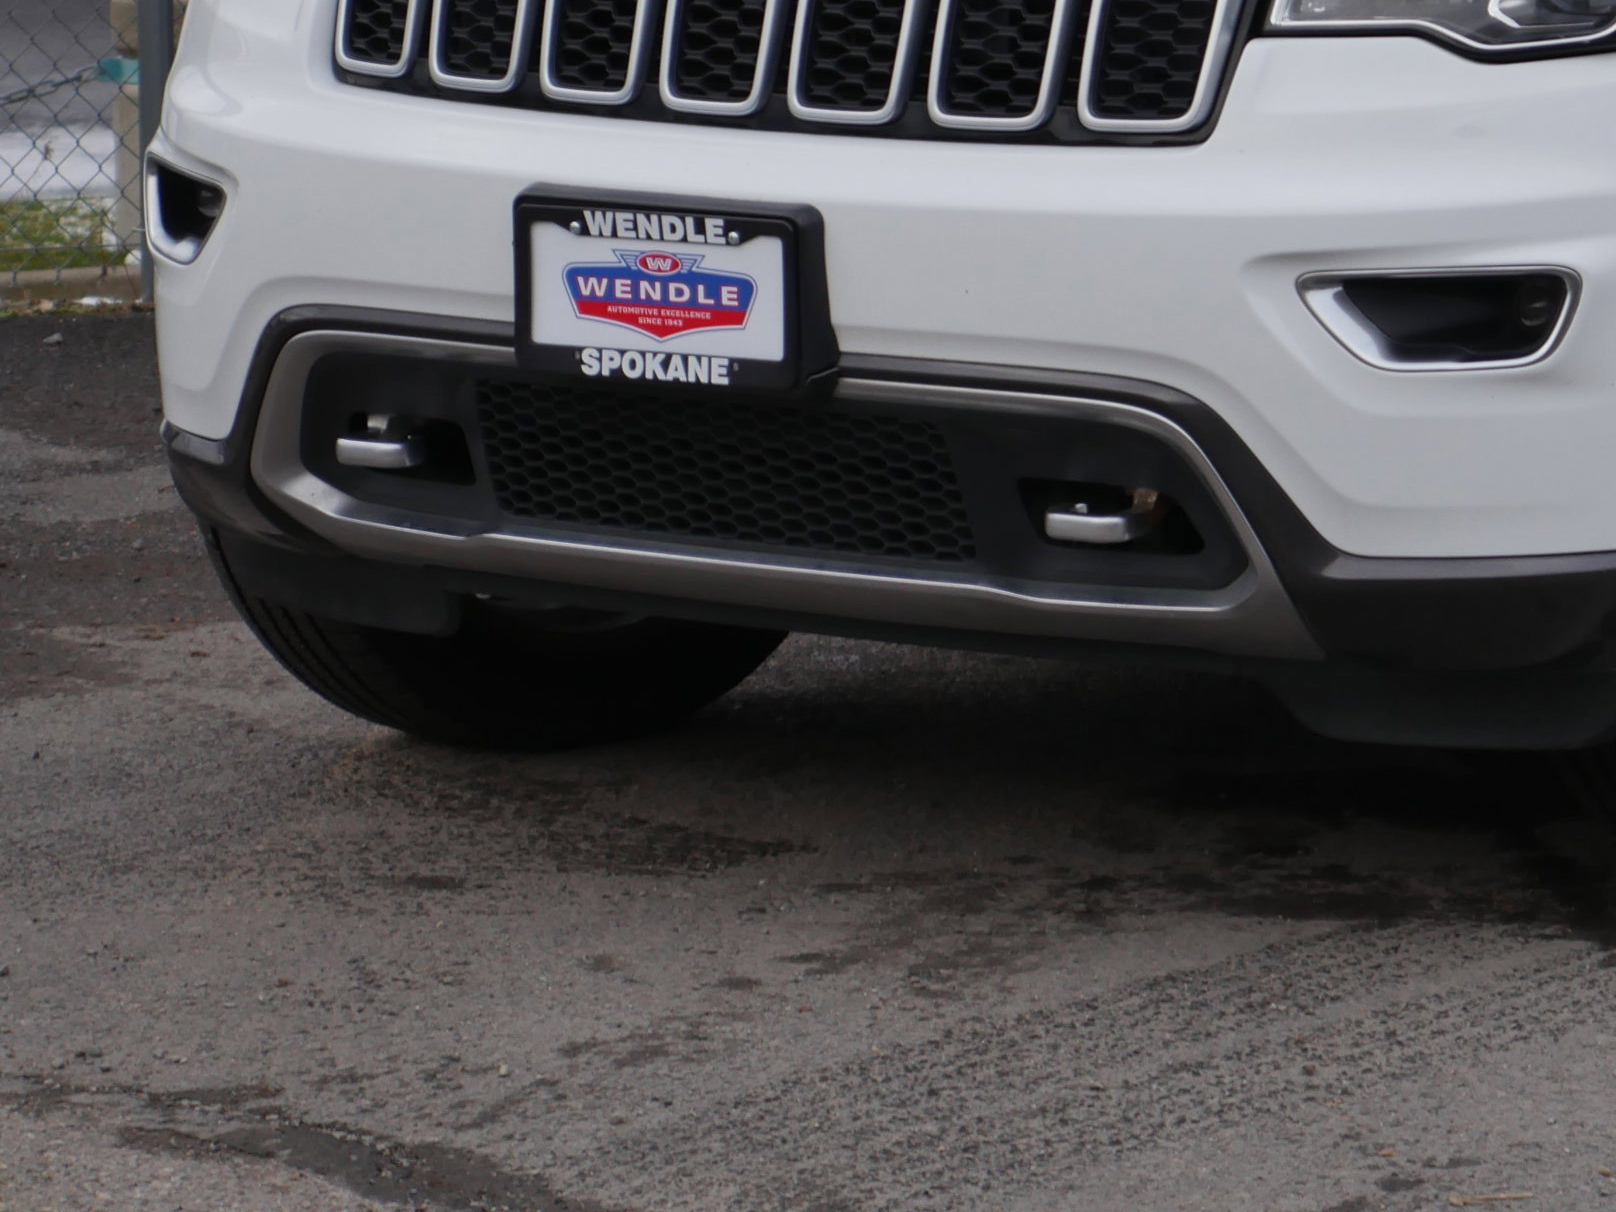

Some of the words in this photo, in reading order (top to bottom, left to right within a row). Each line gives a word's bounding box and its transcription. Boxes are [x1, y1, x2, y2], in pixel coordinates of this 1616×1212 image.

[583, 210, 727, 245] WENDLE
[576, 276, 739, 306] WENDLE
[607, 305, 658, 316] AUTOMOTIVE
[660, 309, 711, 320] EXCELLENCE
[638, 317, 662, 326] SINCE
[664, 319, 684, 327] 1943
[581, 348, 730, 385] SPOKANE
